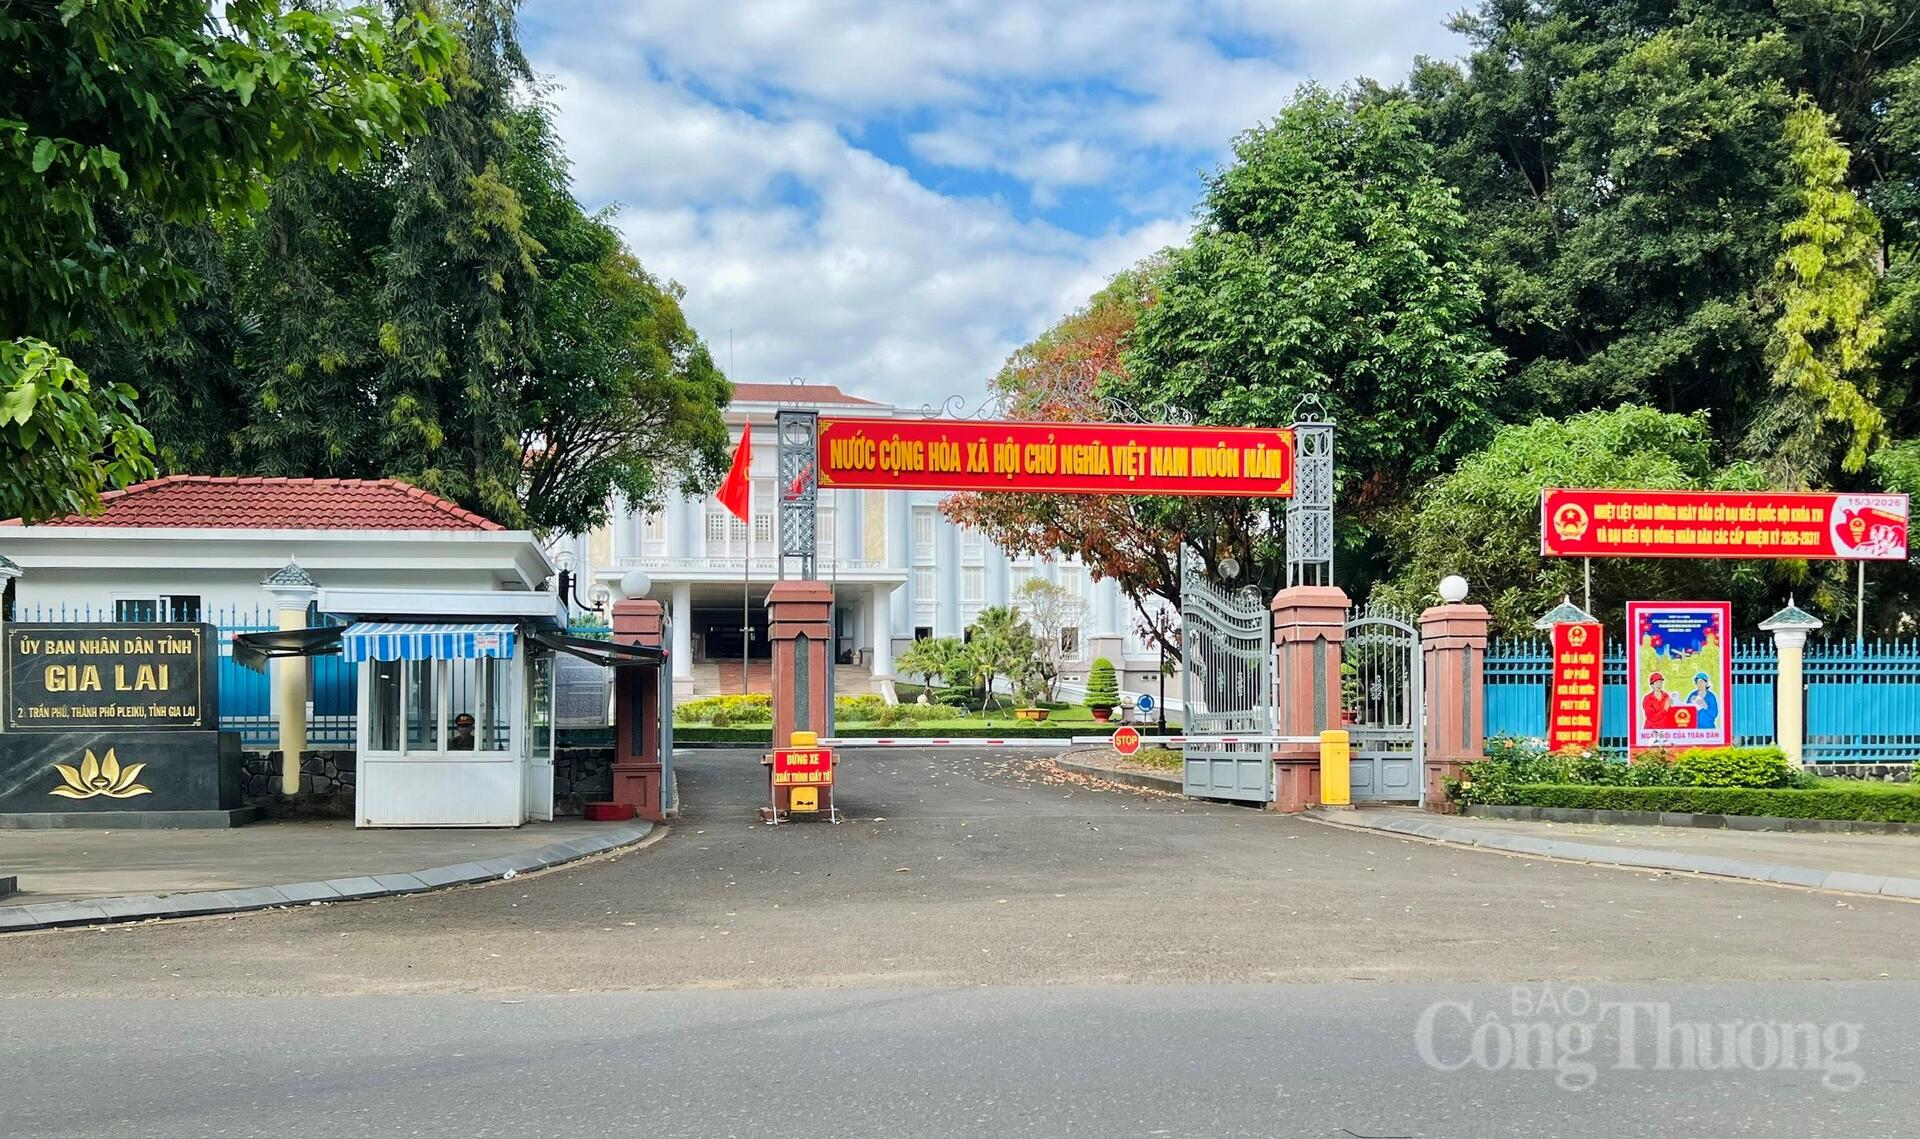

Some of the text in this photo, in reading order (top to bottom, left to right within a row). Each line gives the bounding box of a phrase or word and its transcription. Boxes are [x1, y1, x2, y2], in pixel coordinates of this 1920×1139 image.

[830, 430, 1282, 482] NƯỚC CỘNG HÒA XÃ HỘI CHỦ NGHĨA VIỆT NAM MUÔN NĂM
[1848, 498, 1901, 507] 15/3/2026
[20, 635, 192, 654] ỦY BAN NHÂN DÂN TỈNH
[44, 664, 169, 692] GIA LAI
[71, 704, 97, 718] THÀNH
[99, 702, 116, 717] PHỐ
[117, 706, 147, 719] PLEIKU,
[148, 702, 166, 717] TỈNH
[168, 706, 181, 717] GIA
[182, 706, 196, 717] LAI
[1116, 736, 1137, 746] STOP
[787, 752, 819, 765] DỪNG XE
